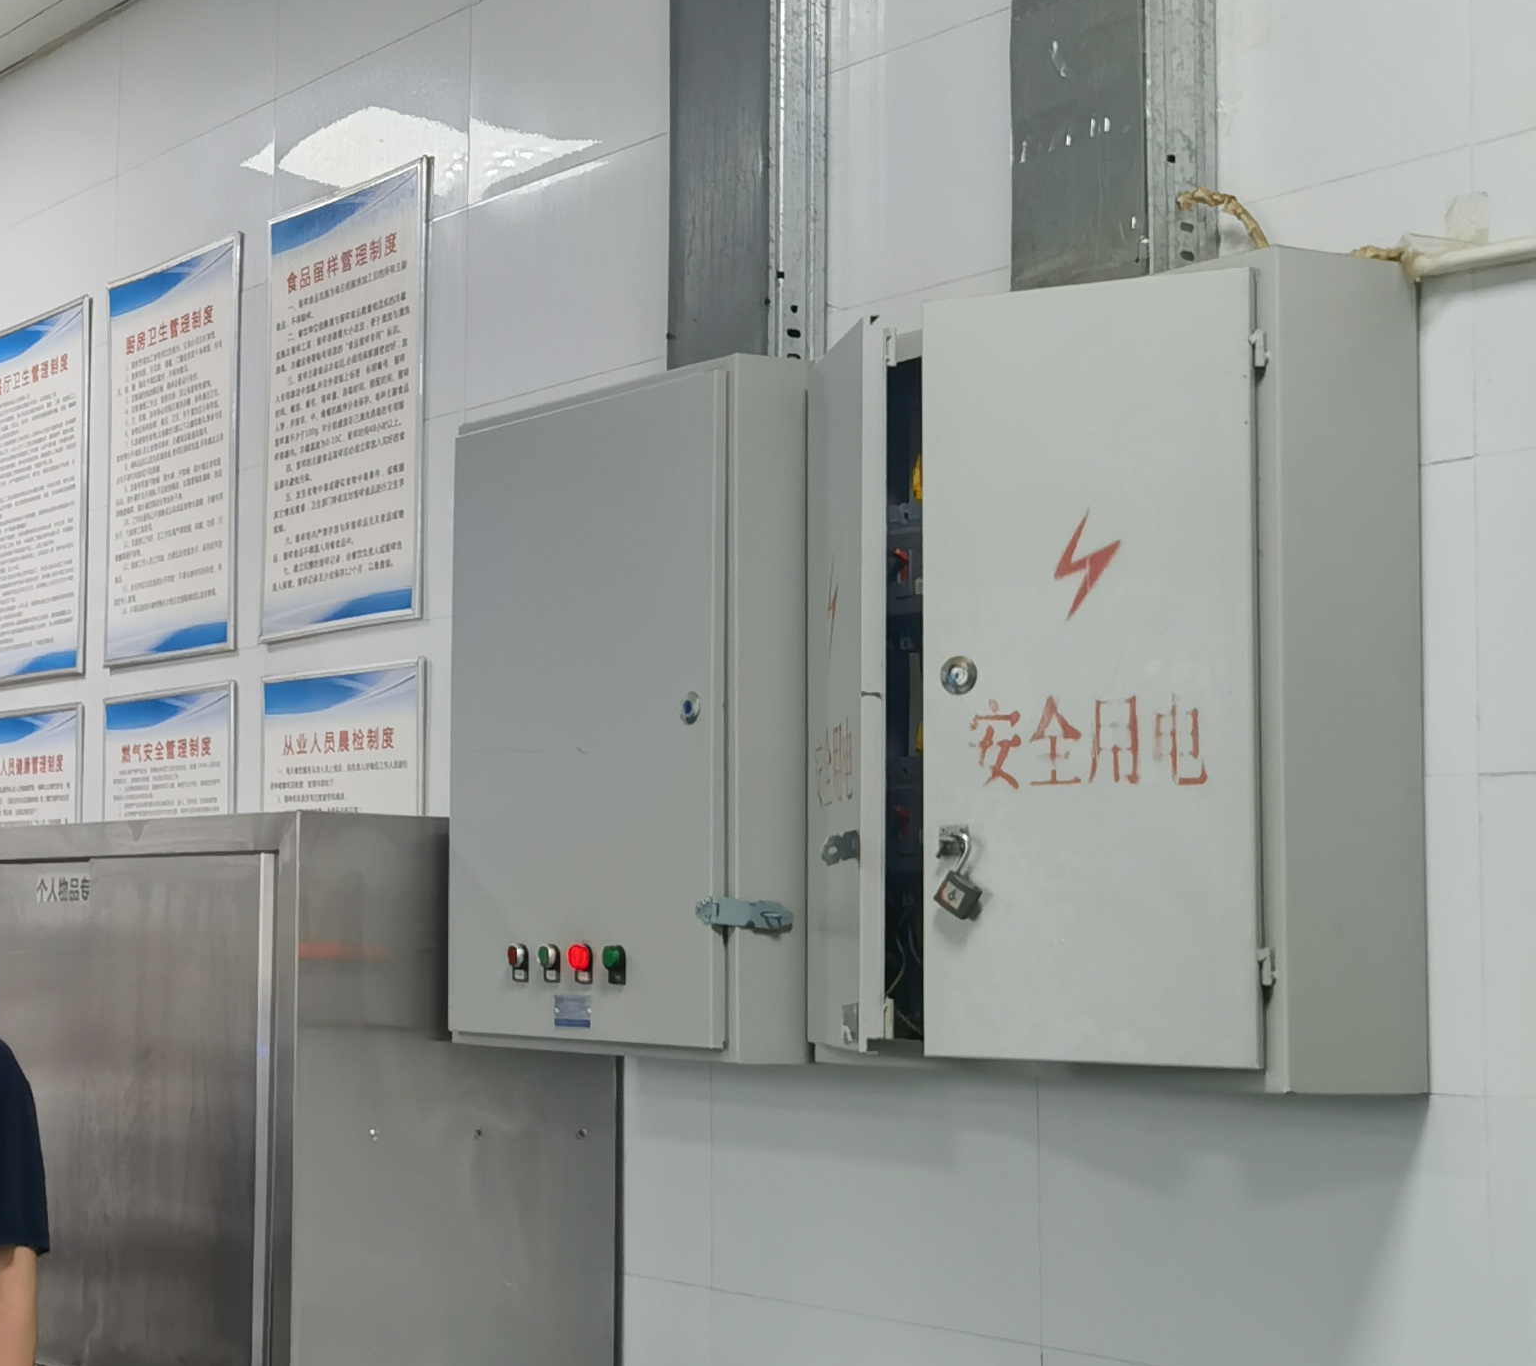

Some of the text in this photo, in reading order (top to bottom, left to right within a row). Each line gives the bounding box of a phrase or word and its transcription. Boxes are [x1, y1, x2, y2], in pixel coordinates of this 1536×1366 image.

[287, 232, 398, 295] 食品留样管理制度
[125, 304, 214, 356] 厨房卫生管理制度
[120, 736, 213, 765] 燃气安全管理制度
[282, 725, 396, 757] 从业人员晨检制度
[967, 692, 1209, 791] 安全用电
